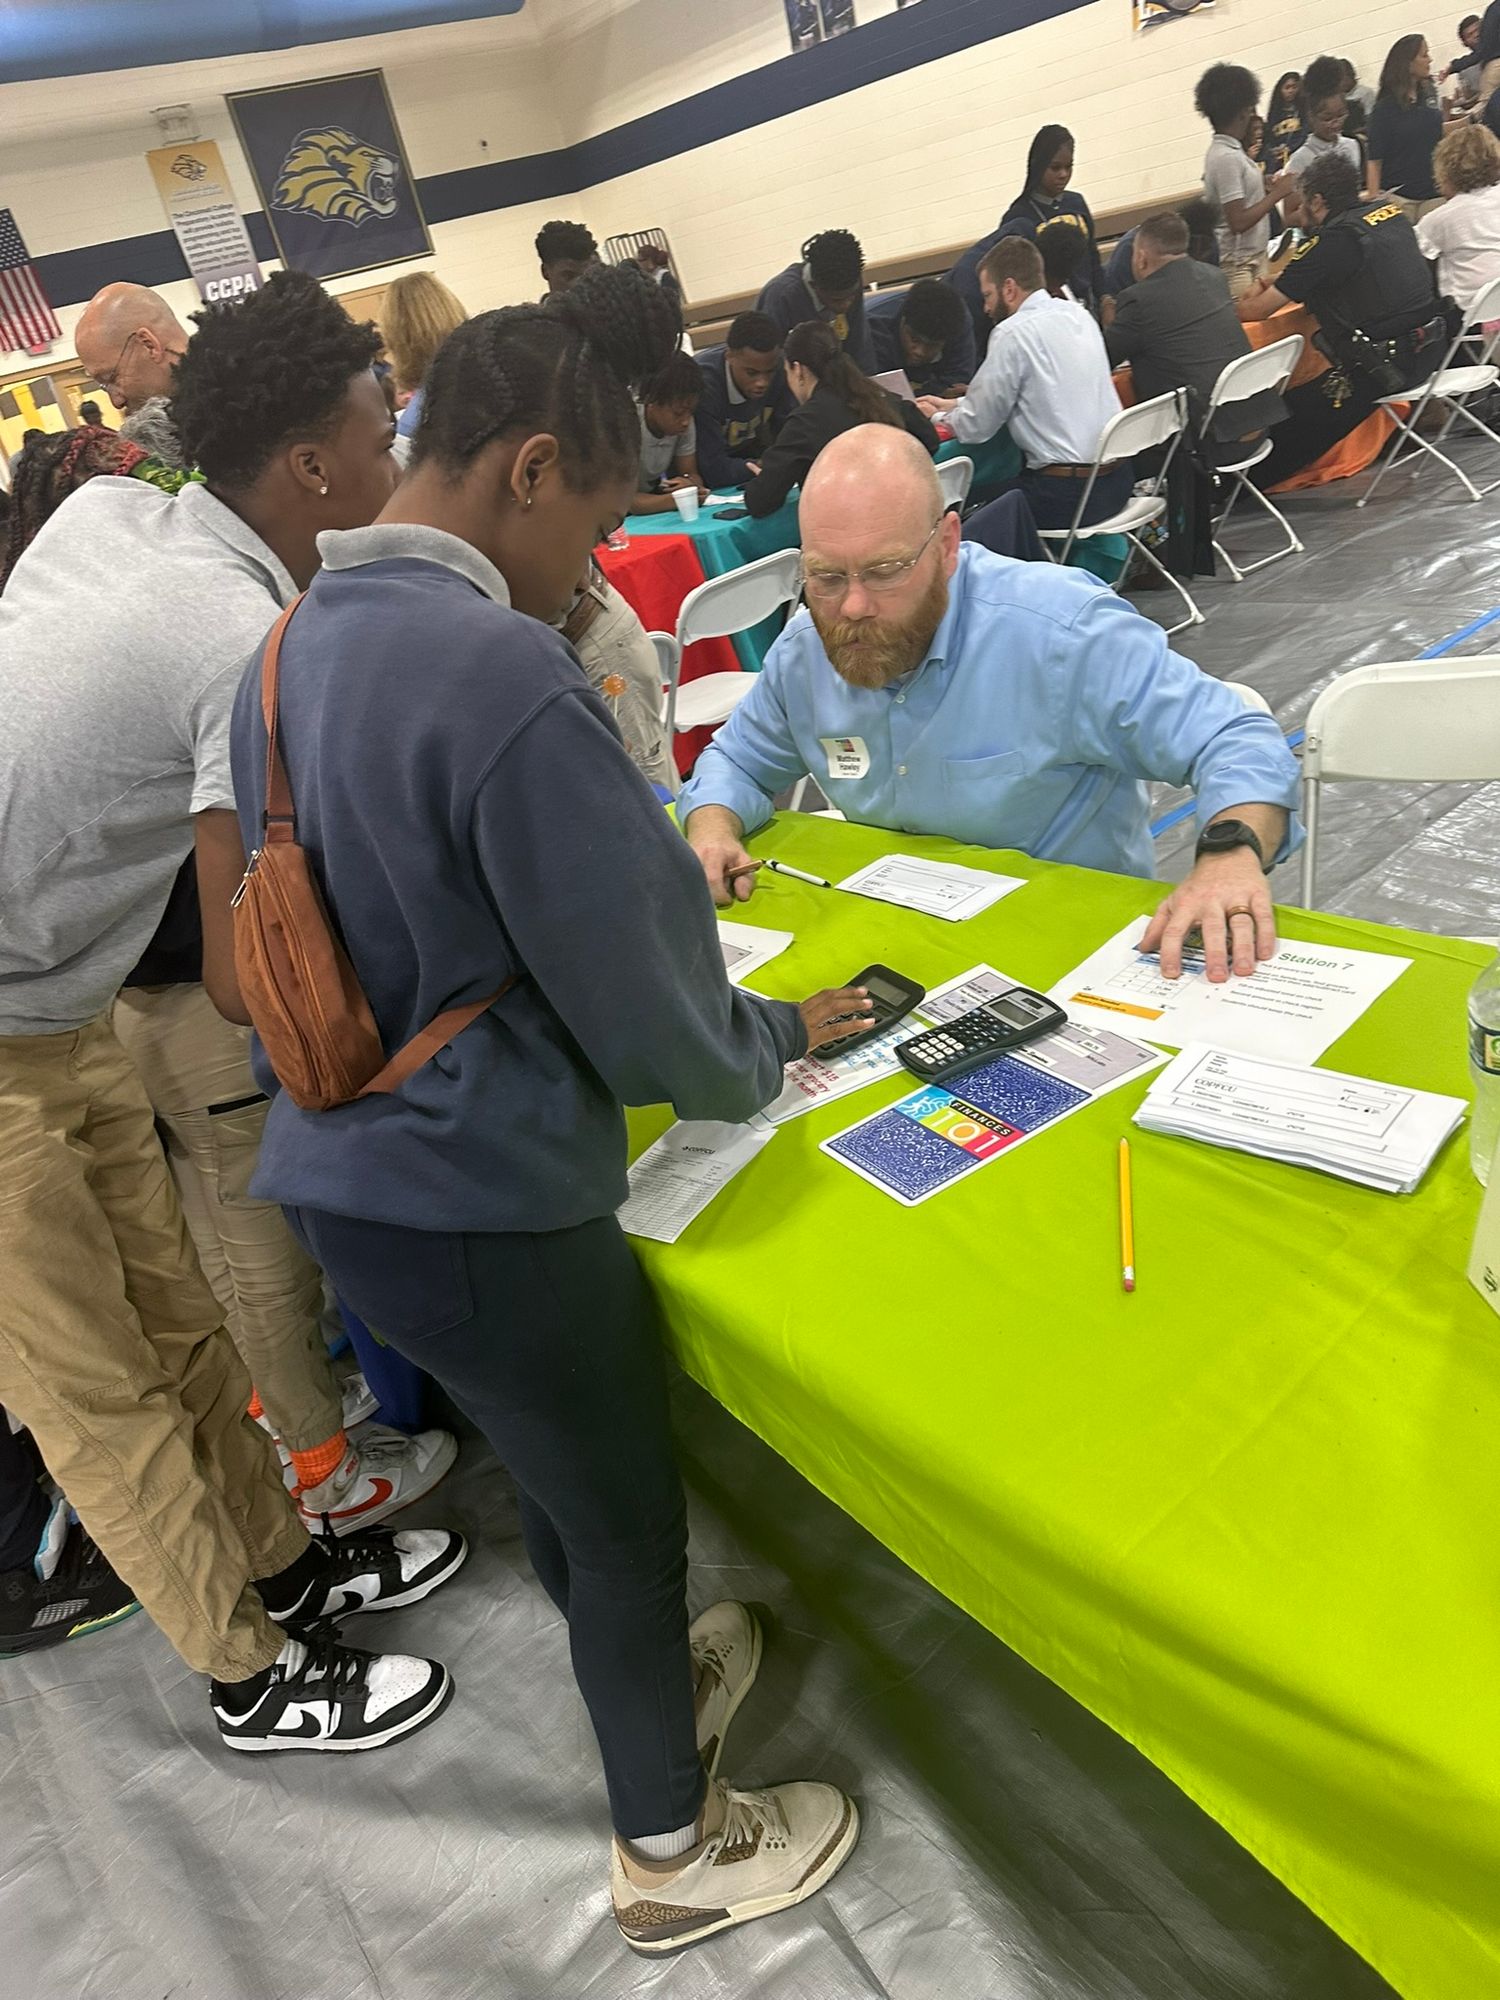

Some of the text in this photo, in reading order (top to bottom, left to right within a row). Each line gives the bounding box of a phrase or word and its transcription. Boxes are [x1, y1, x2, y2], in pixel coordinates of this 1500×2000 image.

[205, 273, 258, 301] CCPA
[1278, 952, 1355, 971] Station 7
[1194, 1078, 1237, 1093] COPFCU
[931, 1110, 1001, 1154] 101
[952, 1101, 1011, 1137] FINANCES
